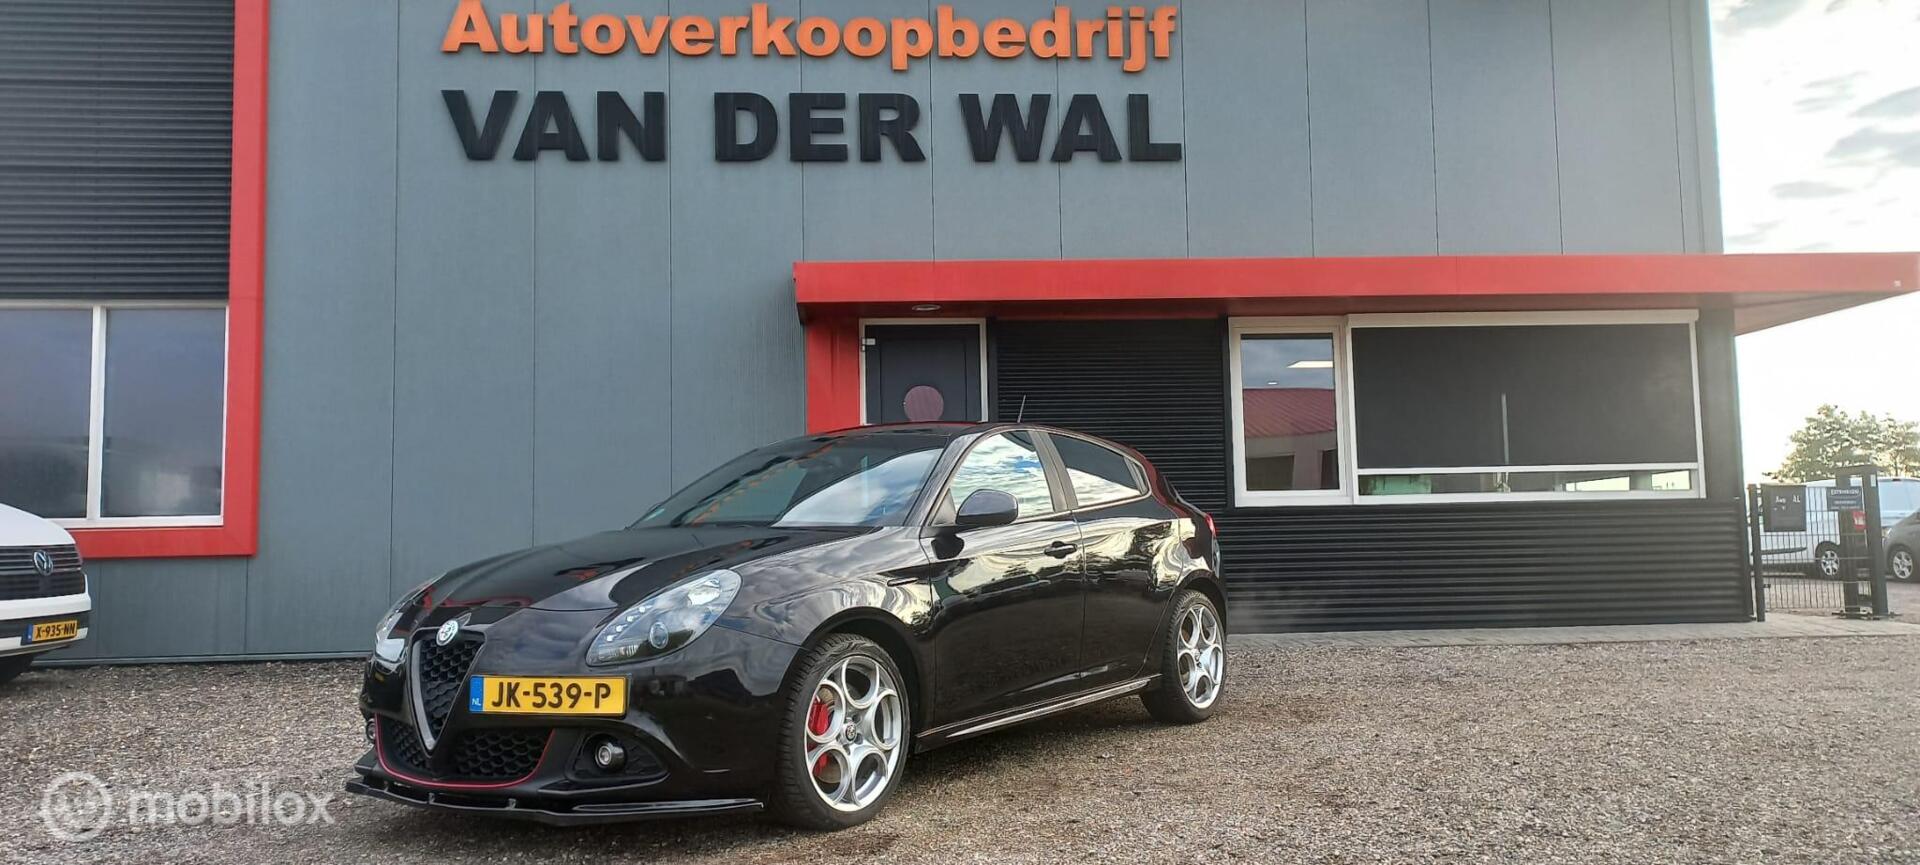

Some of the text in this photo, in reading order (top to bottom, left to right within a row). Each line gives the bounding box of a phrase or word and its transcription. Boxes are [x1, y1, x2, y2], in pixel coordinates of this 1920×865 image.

[441, 0, 1176, 73] Autoverkoopbedrijf
[441, 89, 1182, 163] VAN DER WAL
[35, 622, 76, 640] X-935-NN
[472, 698, 482, 706] NL
[491, 681, 611, 709] JK-539-P
